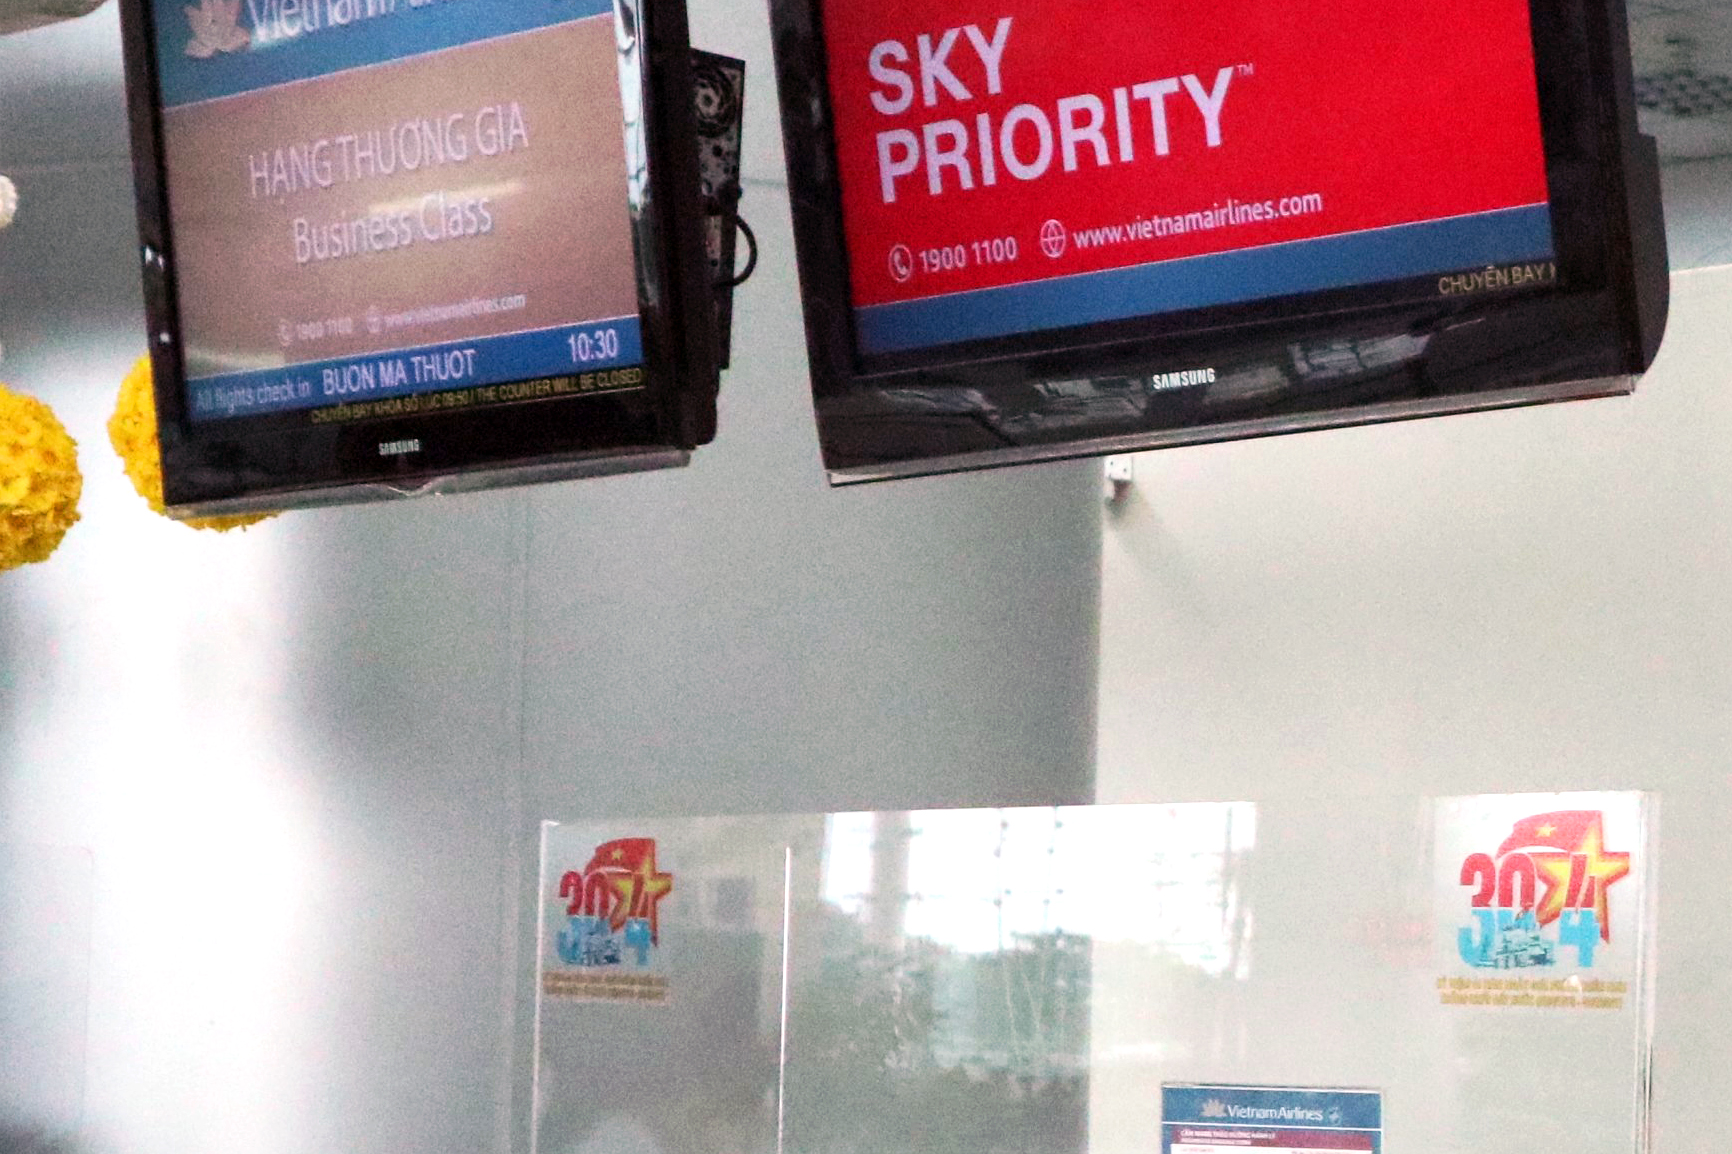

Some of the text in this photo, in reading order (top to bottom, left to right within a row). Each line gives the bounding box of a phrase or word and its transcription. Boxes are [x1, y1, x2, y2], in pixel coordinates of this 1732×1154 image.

[869, 17, 1013, 115] SKY
[475, 101, 529, 155] GIA
[876, 66, 1234, 204] PRIORITY
[293, 190, 493, 263] Business Class
[918, 192, 1323, 273] 1900 1100 www.vietnamairlines.com
[1511, 262, 1545, 285] BAY
[257, 376, 295, 404] check
[322, 365, 375, 395] BUON
[379, 359, 407, 388] MA
[411, 349, 476, 383] THUOT
[568, 328, 618, 363] 10:30
[501, 379, 551, 401] COUNTER
[597, 367, 642, 388] CLOSED
[1153, 367, 1216, 390] SAMSUNG
[378, 438, 420, 456] SAMSUNG
[1228, 1104, 1324, 1122] Vietnam Airlines
